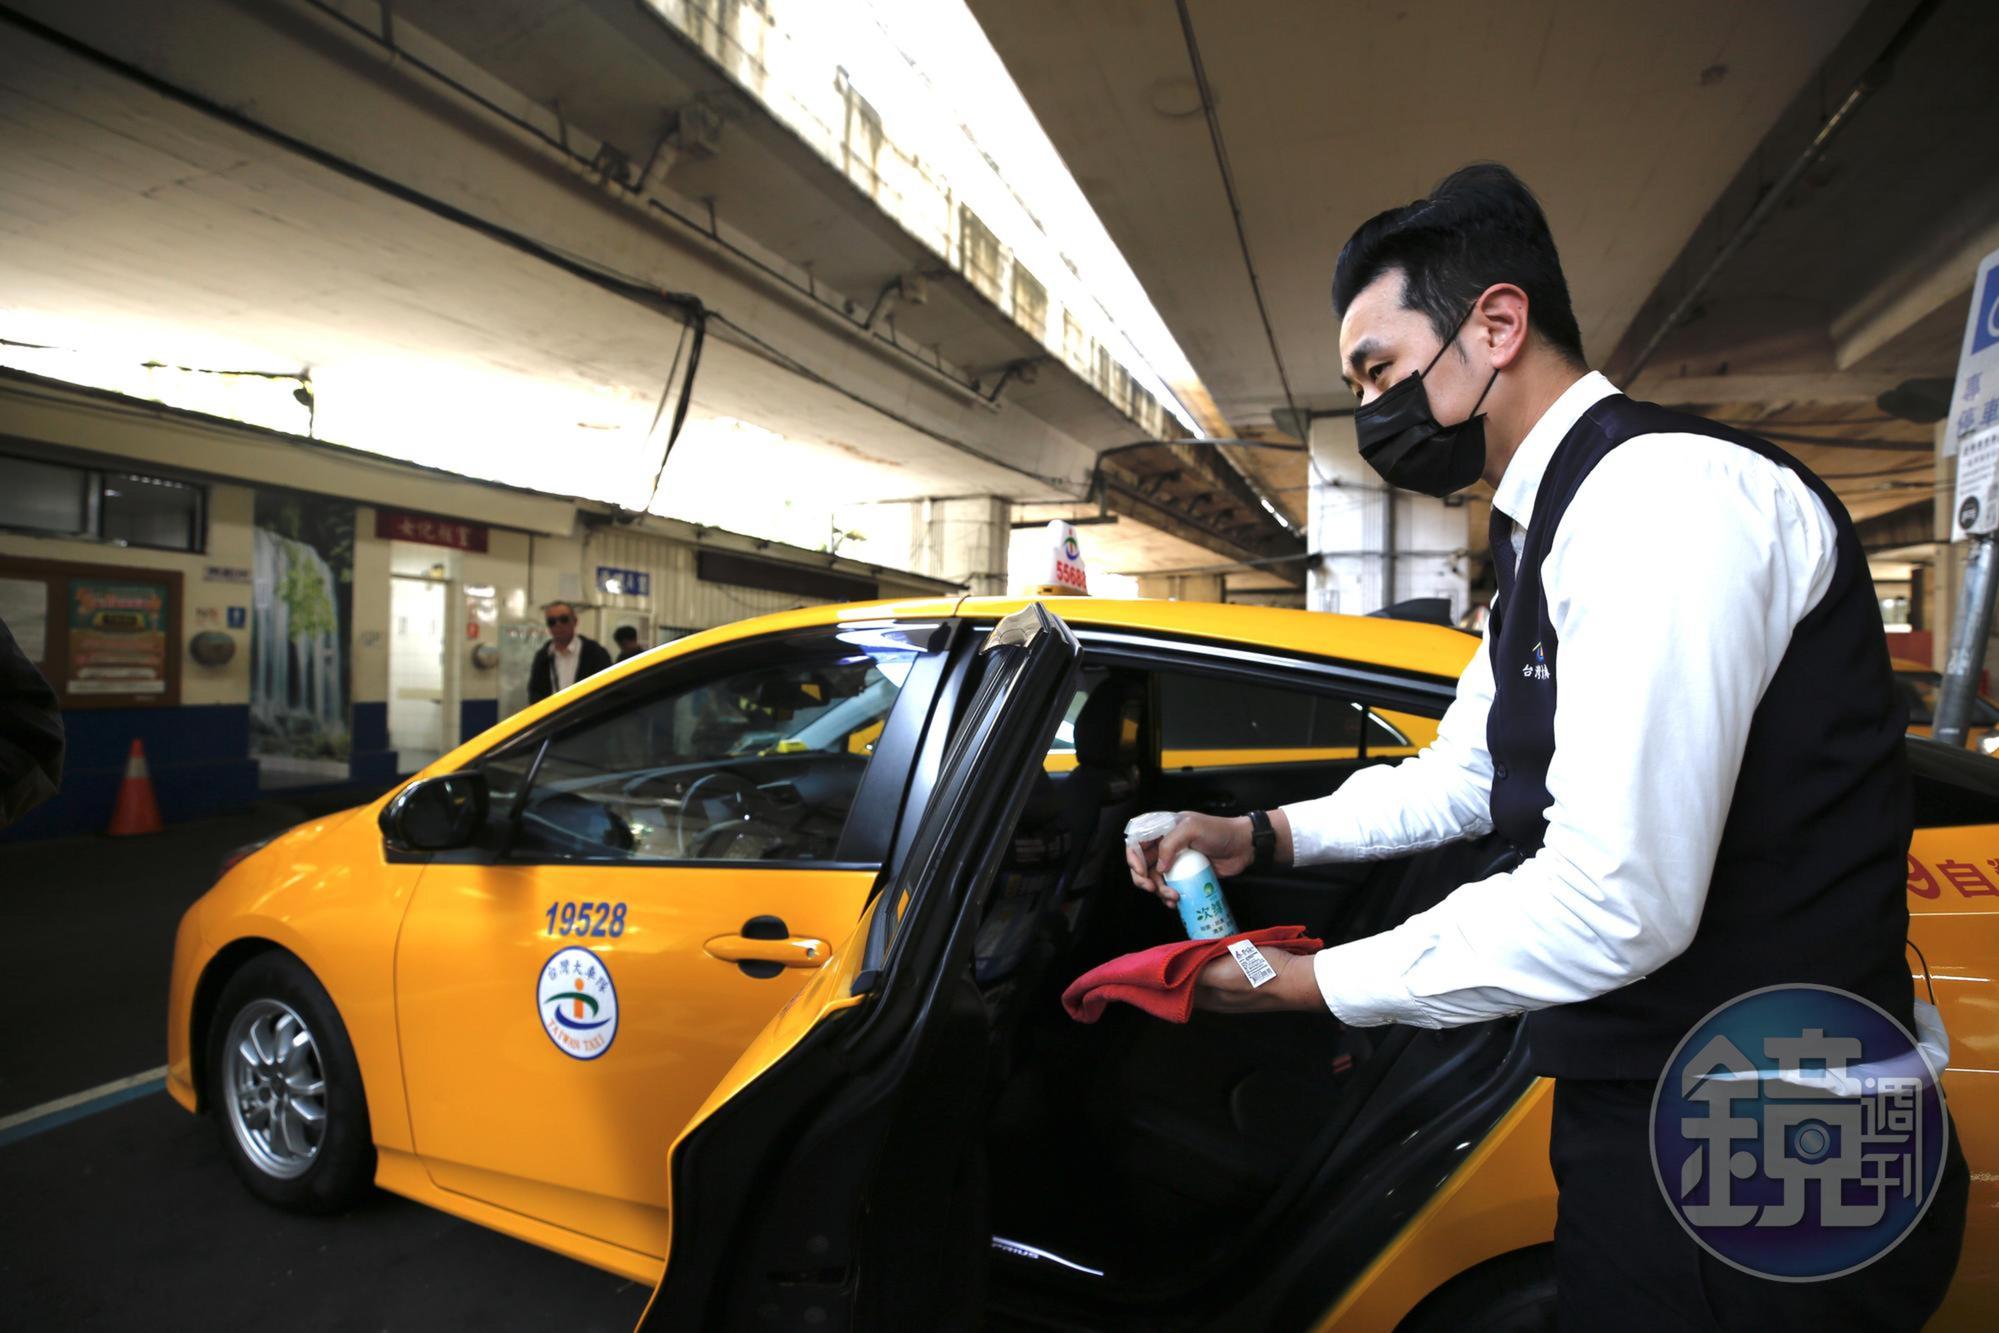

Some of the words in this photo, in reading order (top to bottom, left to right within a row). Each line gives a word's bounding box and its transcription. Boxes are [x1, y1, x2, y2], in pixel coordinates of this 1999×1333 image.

[545, 901, 628, 938] 19528
[548, 959, 609, 993] 台灣大車隊
[546, 1018, 581, 1050] TAIWAN
[583, 1034, 605, 1052] TAXI
